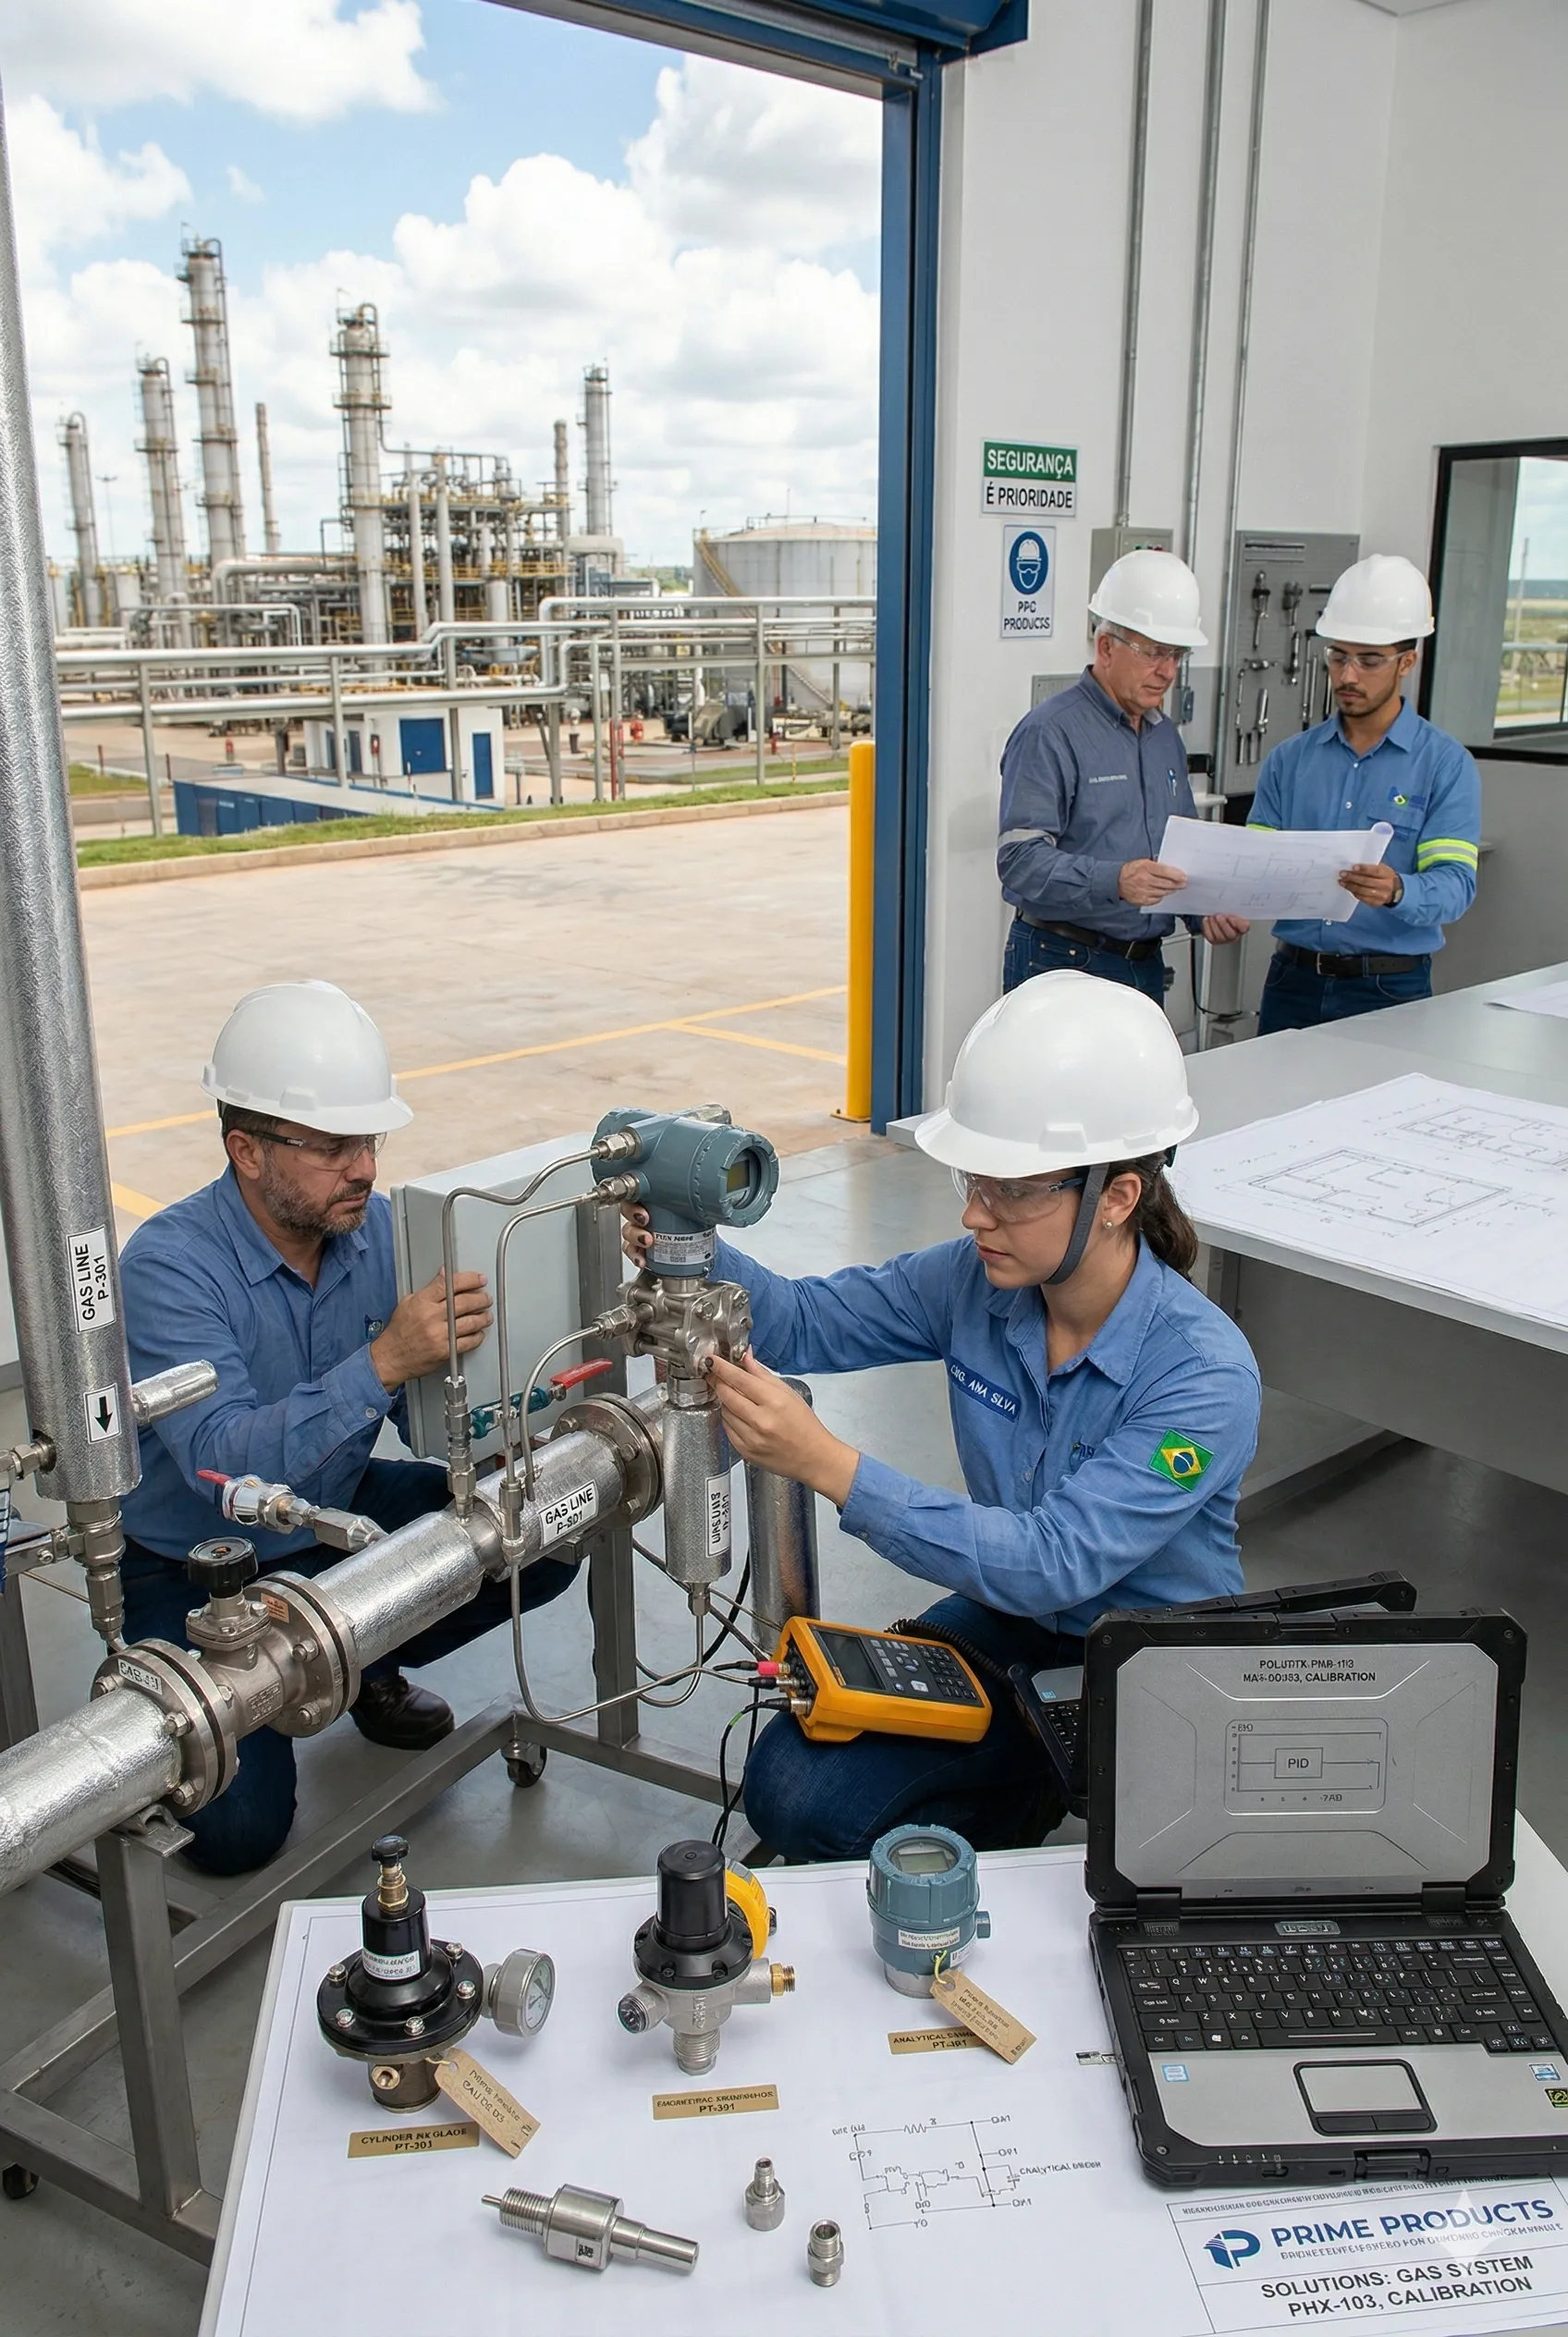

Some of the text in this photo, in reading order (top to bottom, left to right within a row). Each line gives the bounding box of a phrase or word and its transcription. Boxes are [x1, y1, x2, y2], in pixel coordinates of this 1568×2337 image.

[987, 449, 1073, 479] SEGURANÇA
[986, 482, 1072, 508] É PRIORIDADE
[75, 1243, 95, 1320] GAS LINE
[93, 1255, 108, 1300] P-301
[968, 1379, 987, 1398] ANA
[545, 1488, 594, 1524] GAS LINE
[1305, 1672, 1377, 1682] CALIBRATION
[1288, 1758, 1309, 1768] PID
[893, 2034, 945, 2044] ANALYTICAL
[361, 2133, 413, 2145] CYLINDER
[1271, 2219, 1375, 2247] PRIME
[1379, 2199, 1554, 2235] PRODUCTS
[1261, 2256, 1534, 2298] SOLUTIONS: GAS SYSTEM
[1288, 2276, 1533, 2318] PHX-103, CALIBRATION
